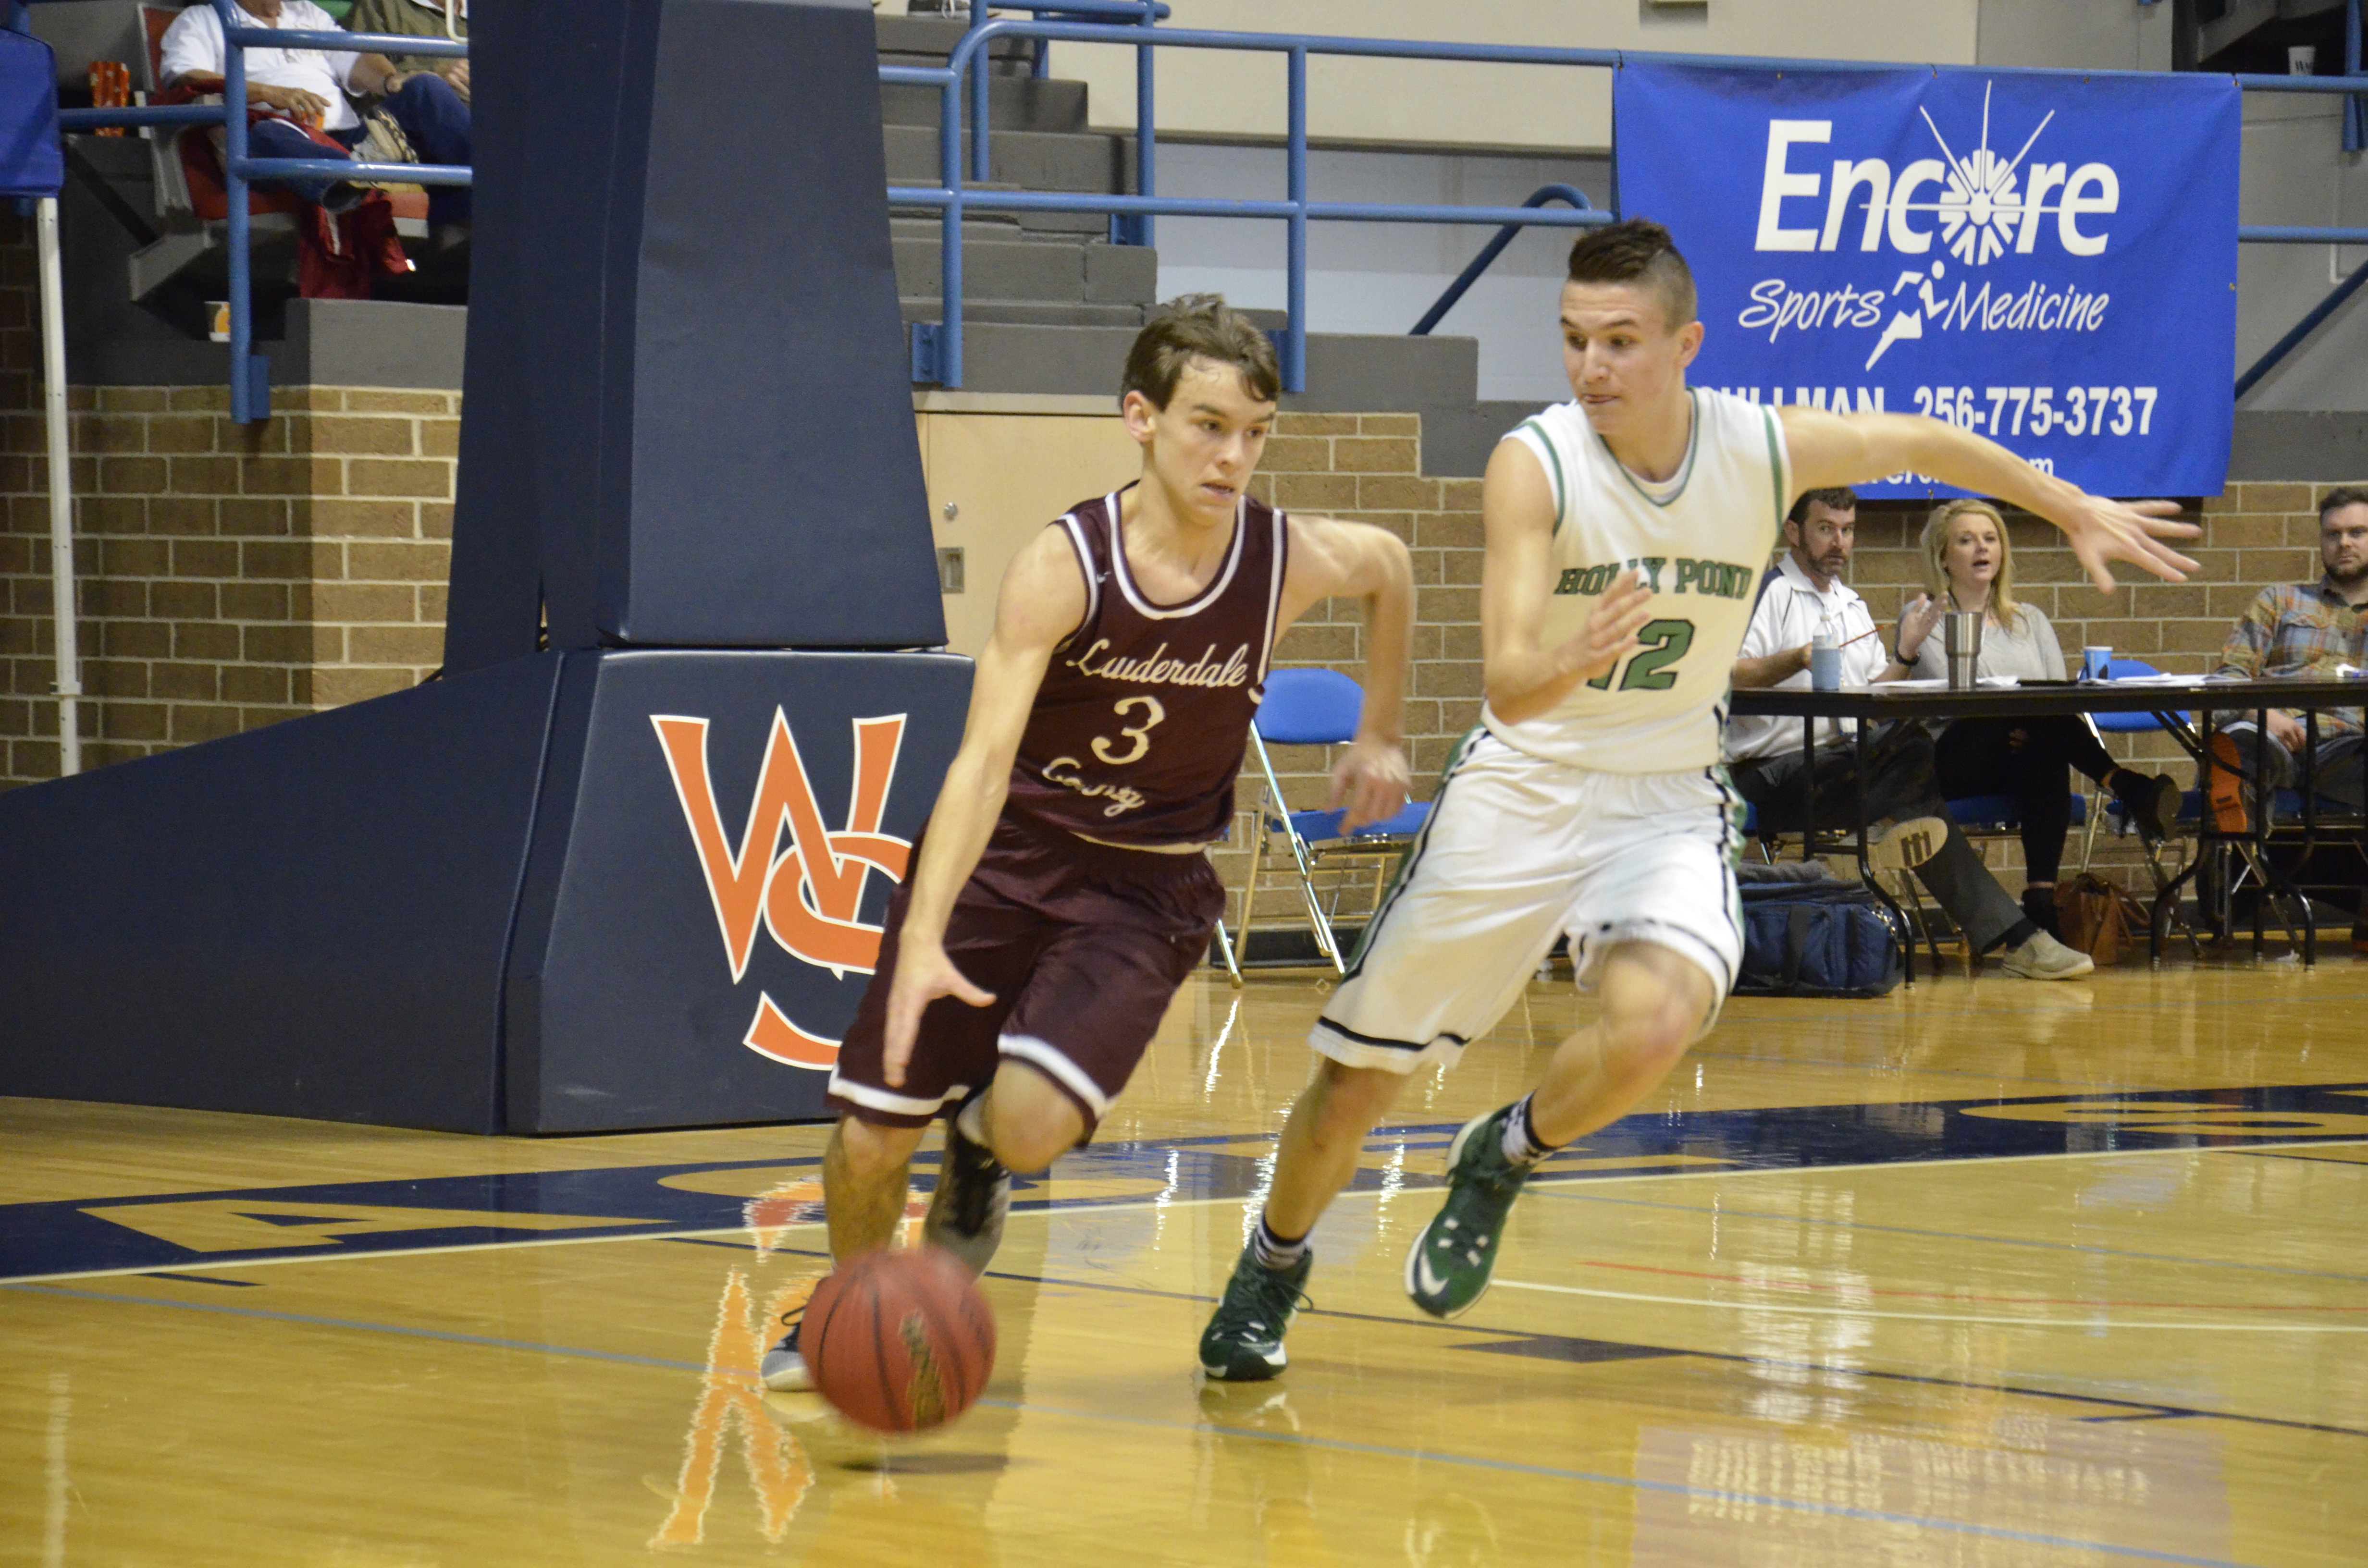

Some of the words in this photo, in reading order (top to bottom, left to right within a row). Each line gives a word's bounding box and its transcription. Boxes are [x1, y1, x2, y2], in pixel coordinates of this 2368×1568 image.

[1738, 279, 1885, 343] Sports
[1941, 281, 2110, 331] Medicine
[1913, 386, 2158, 436] 256-775-3737
[1674, 558, 1753, 600] POND
[1066, 638, 1249, 688] Lauderdale
[1091, 696, 1165, 765] 3
